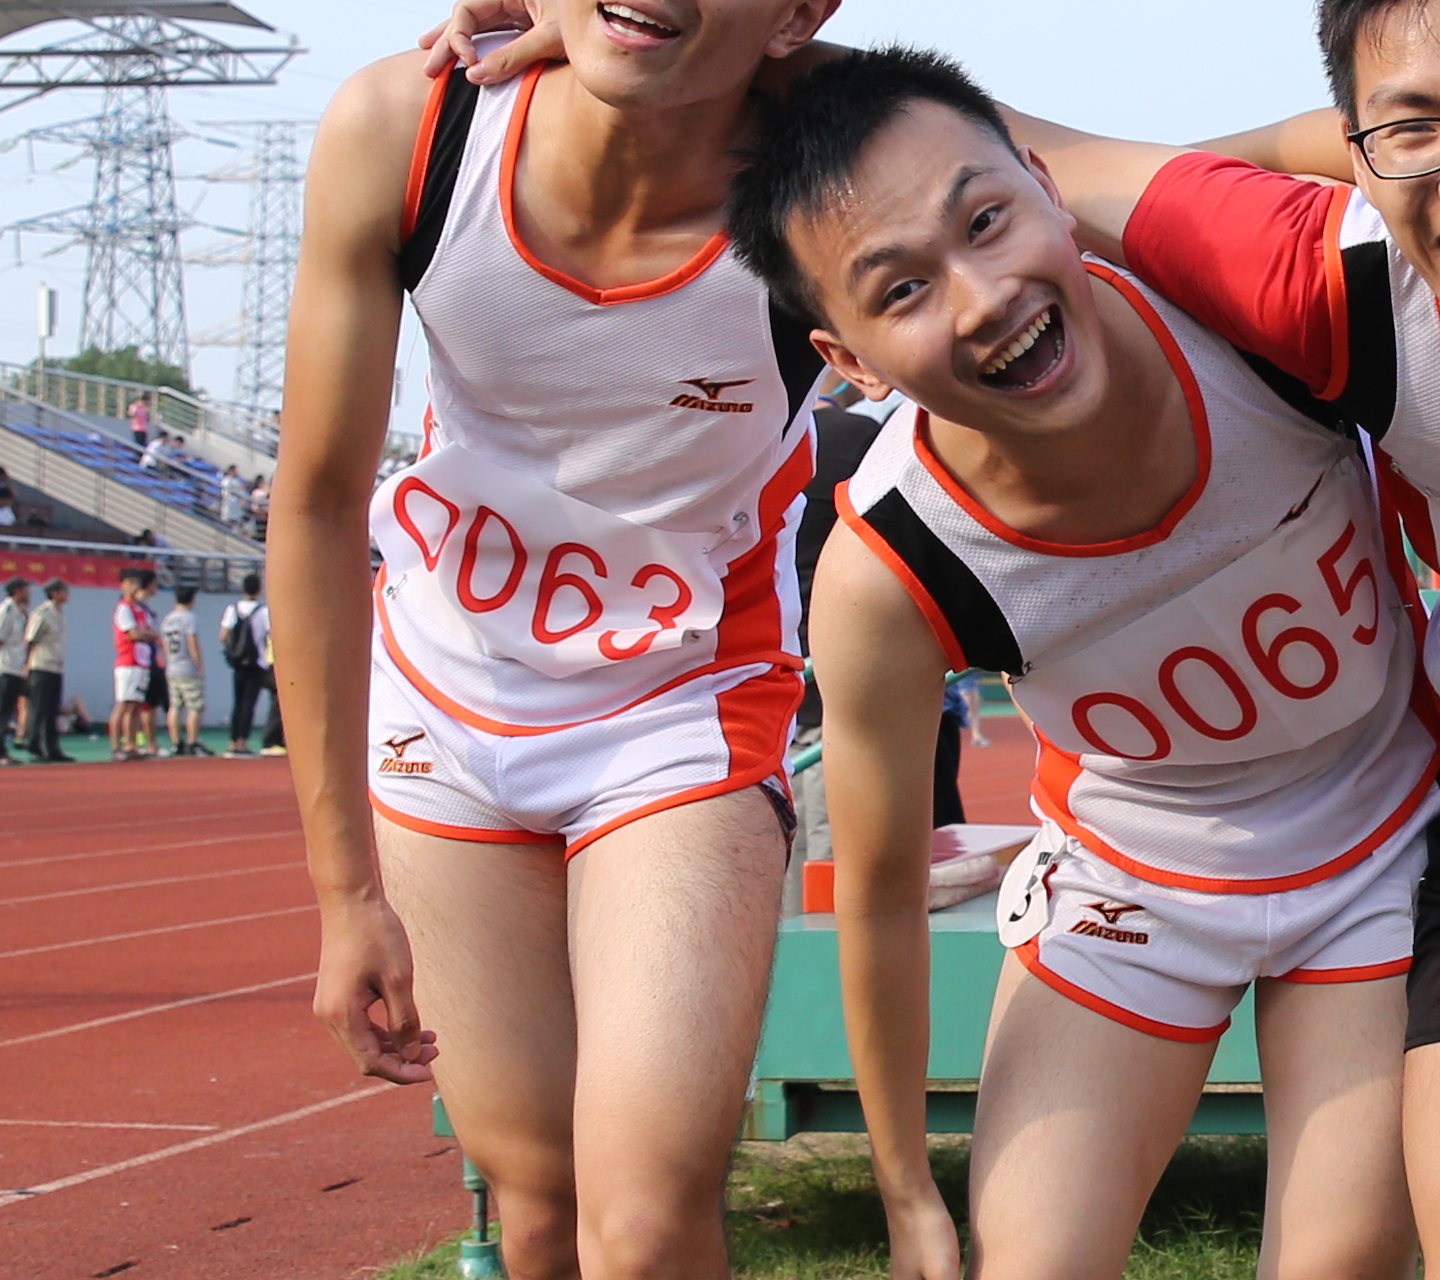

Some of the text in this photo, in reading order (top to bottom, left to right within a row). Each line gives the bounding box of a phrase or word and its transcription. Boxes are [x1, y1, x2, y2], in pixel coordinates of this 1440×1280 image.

[668, 393, 755, 413] MIZUNO
[392, 475, 693, 661] 0063
[1070, 518, 1380, 762] 0065
[1066, 919, 1150, 946] MIZUNO
